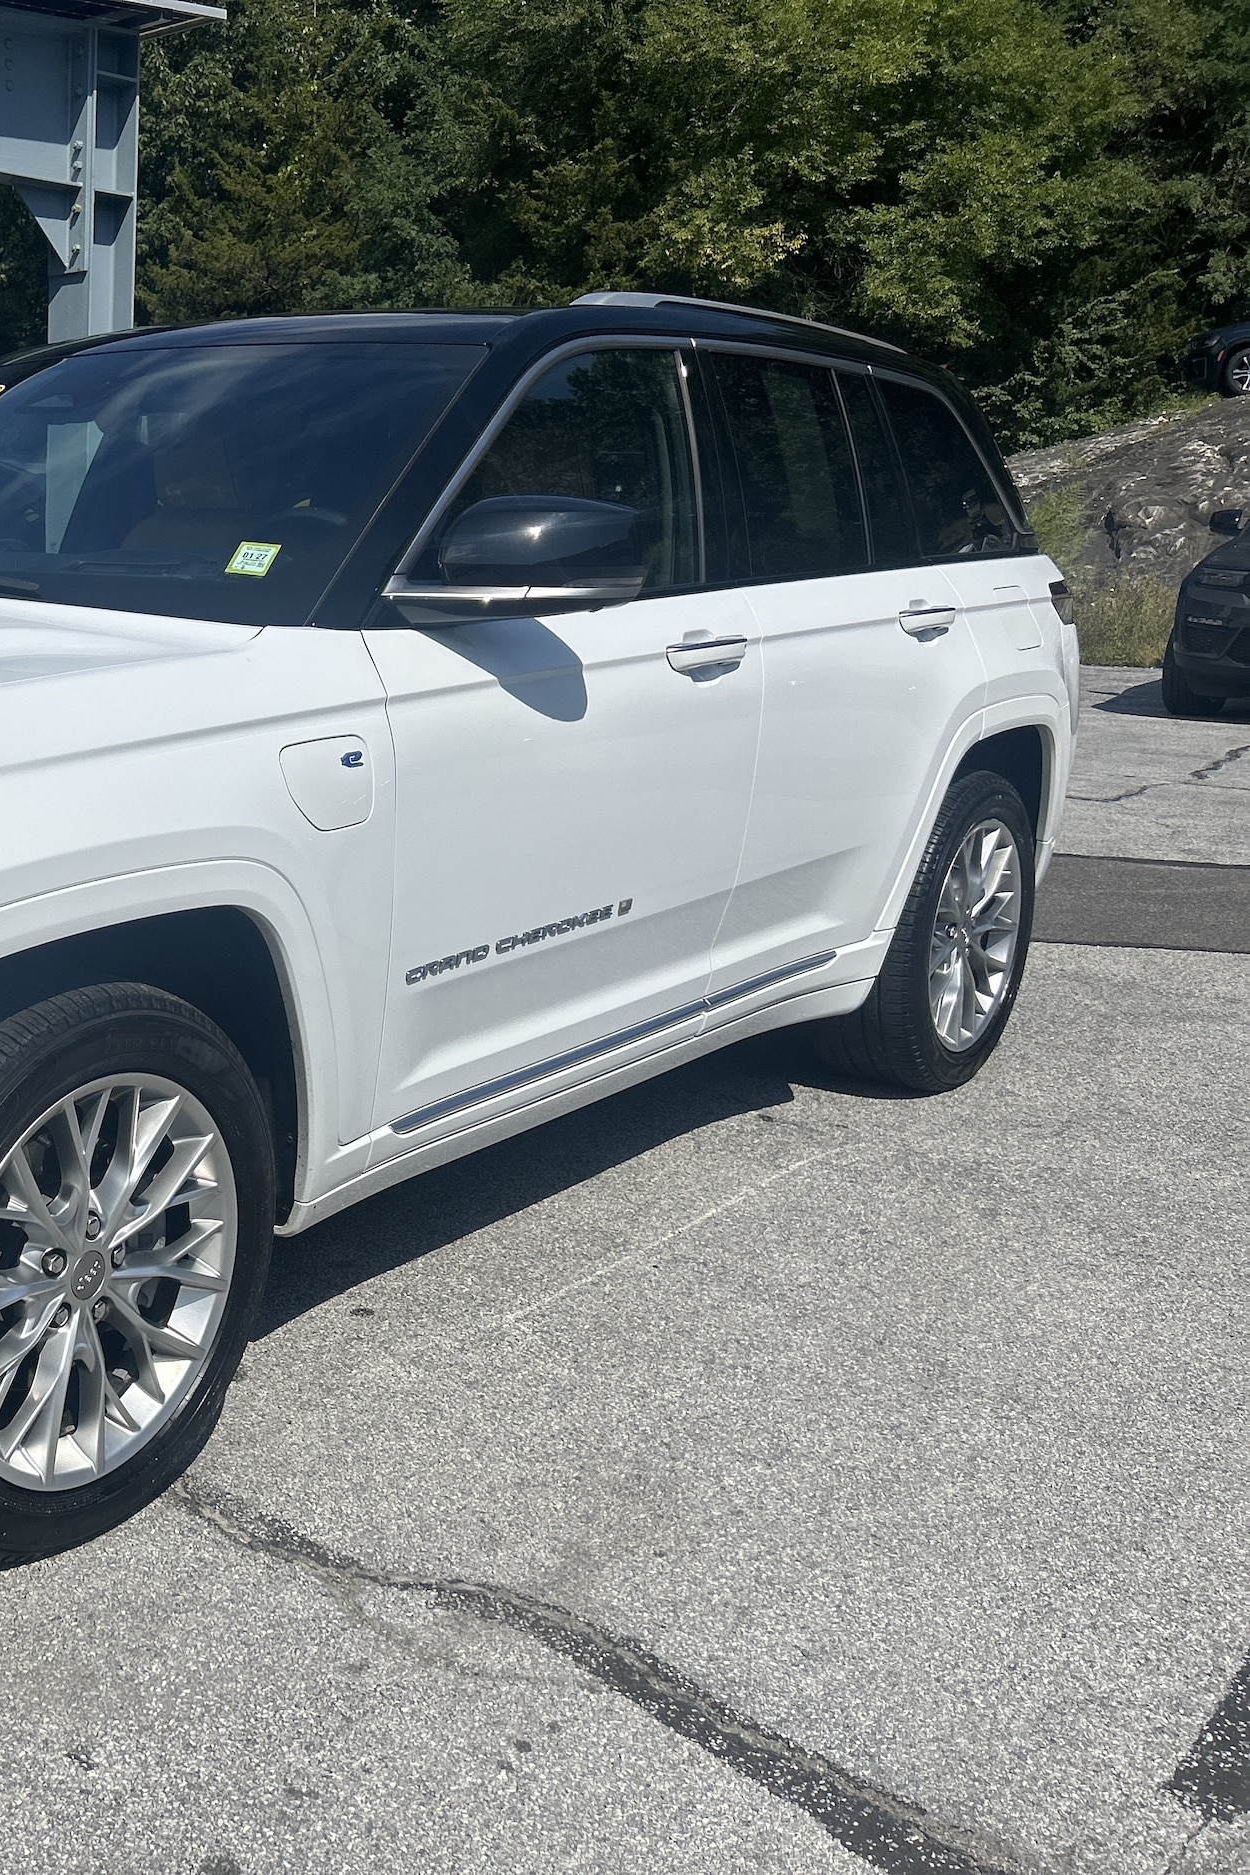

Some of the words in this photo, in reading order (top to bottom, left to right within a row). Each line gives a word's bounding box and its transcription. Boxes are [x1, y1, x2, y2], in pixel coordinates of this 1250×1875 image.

[242, 551, 255, 559] 01
[405, 944, 490, 986] GRAND
[495, 904, 614, 955] CHEROKEE
